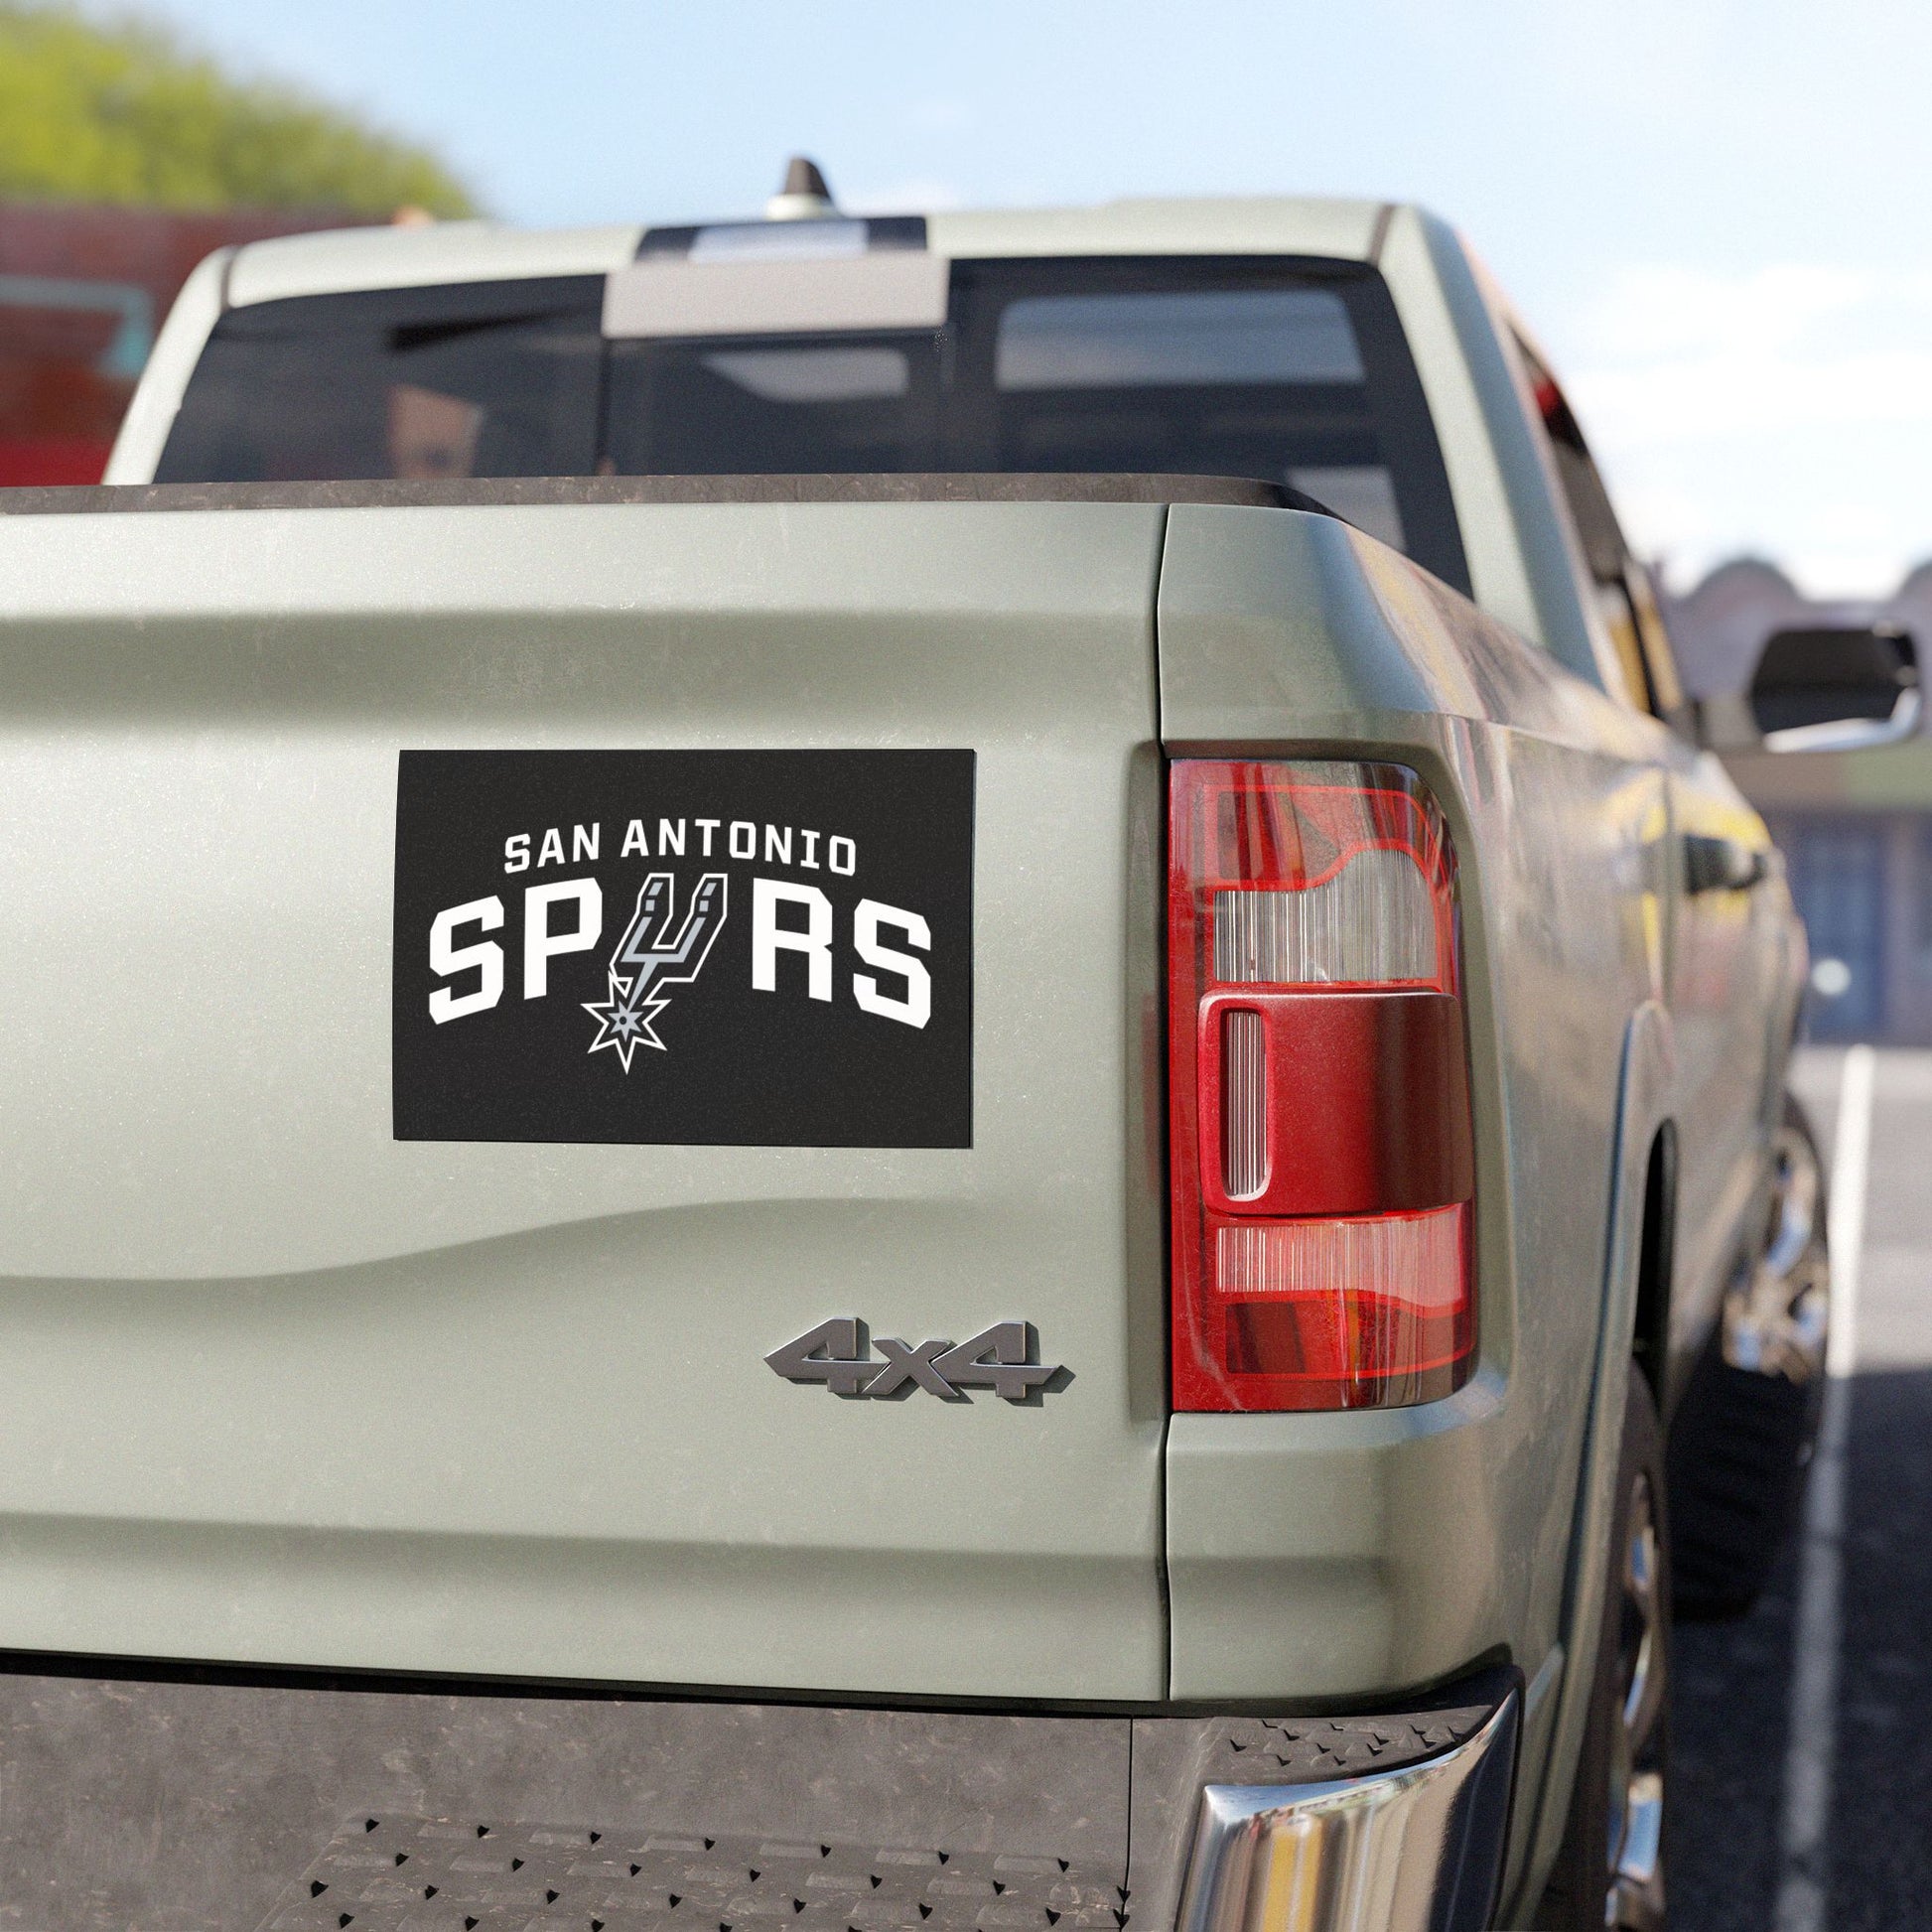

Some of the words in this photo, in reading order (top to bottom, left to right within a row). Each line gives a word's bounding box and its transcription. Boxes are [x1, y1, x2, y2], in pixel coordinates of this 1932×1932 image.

[504, 823, 601, 875] SAN
[621, 819, 857, 877] ANTONIO
[429, 873, 931, 1074] SPURS
[763, 1316, 1064, 1400] 4x4
